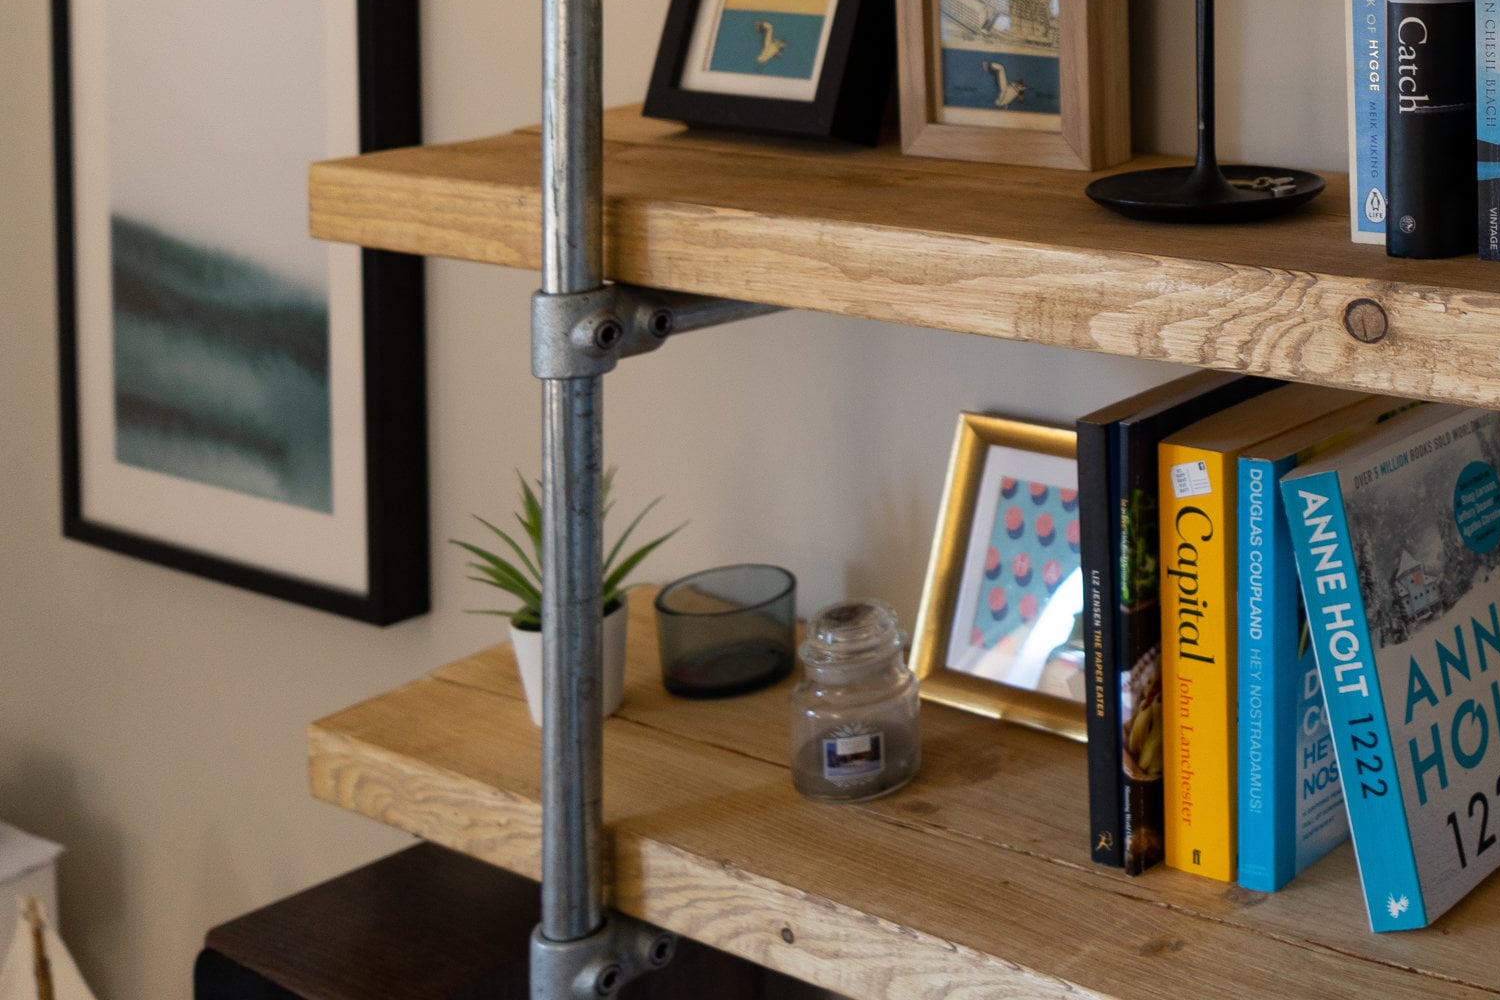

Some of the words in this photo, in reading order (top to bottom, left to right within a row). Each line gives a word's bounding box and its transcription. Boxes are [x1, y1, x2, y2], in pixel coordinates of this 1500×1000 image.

[1366, 14, 1377, 34] OF
[1485, 19, 1496, 72] CHESIL
[1368, 39, 1380, 92] HYGGE
[1398, 16, 1430, 115] Catch
[1369, 101, 1378, 129] MEIK
[1486, 79, 1497, 127] BEACH
[1370, 134, 1379, 180] WIKING
[1489, 207, 1499, 250] VINTAGE
[1354, 470, 1374, 489] OVER
[1374, 465, 1380, 480] 5
[1380, 452, 1409, 477] MILLION
[1409, 440, 1432, 462] BOOKS
[1433, 431, 1451, 450] SOLD
[1249, 469, 1262, 546] DOUGLAS
[1298, 490, 1347, 596] ANNE
[1092, 569, 1100, 586] LIZ
[1167, 507, 1215, 666] Capital
[1249, 550, 1262, 640] COUPLAND
[1092, 588, 1102, 627] JENSEN
[1094, 630, 1103, 649] THE
[1249, 648, 1262, 678] HEY
[1322, 602, 1369, 698] HOLT
[1095, 652, 1104, 683] PAPER
[1096, 685, 1105, 717] EATER
[1176, 674, 1194, 714] John
[1178, 720, 1196, 827] Lanchester
[1249, 683, 1262, 814] NOSTRADAMUS!
[1348, 713, 1388, 799] 1222
